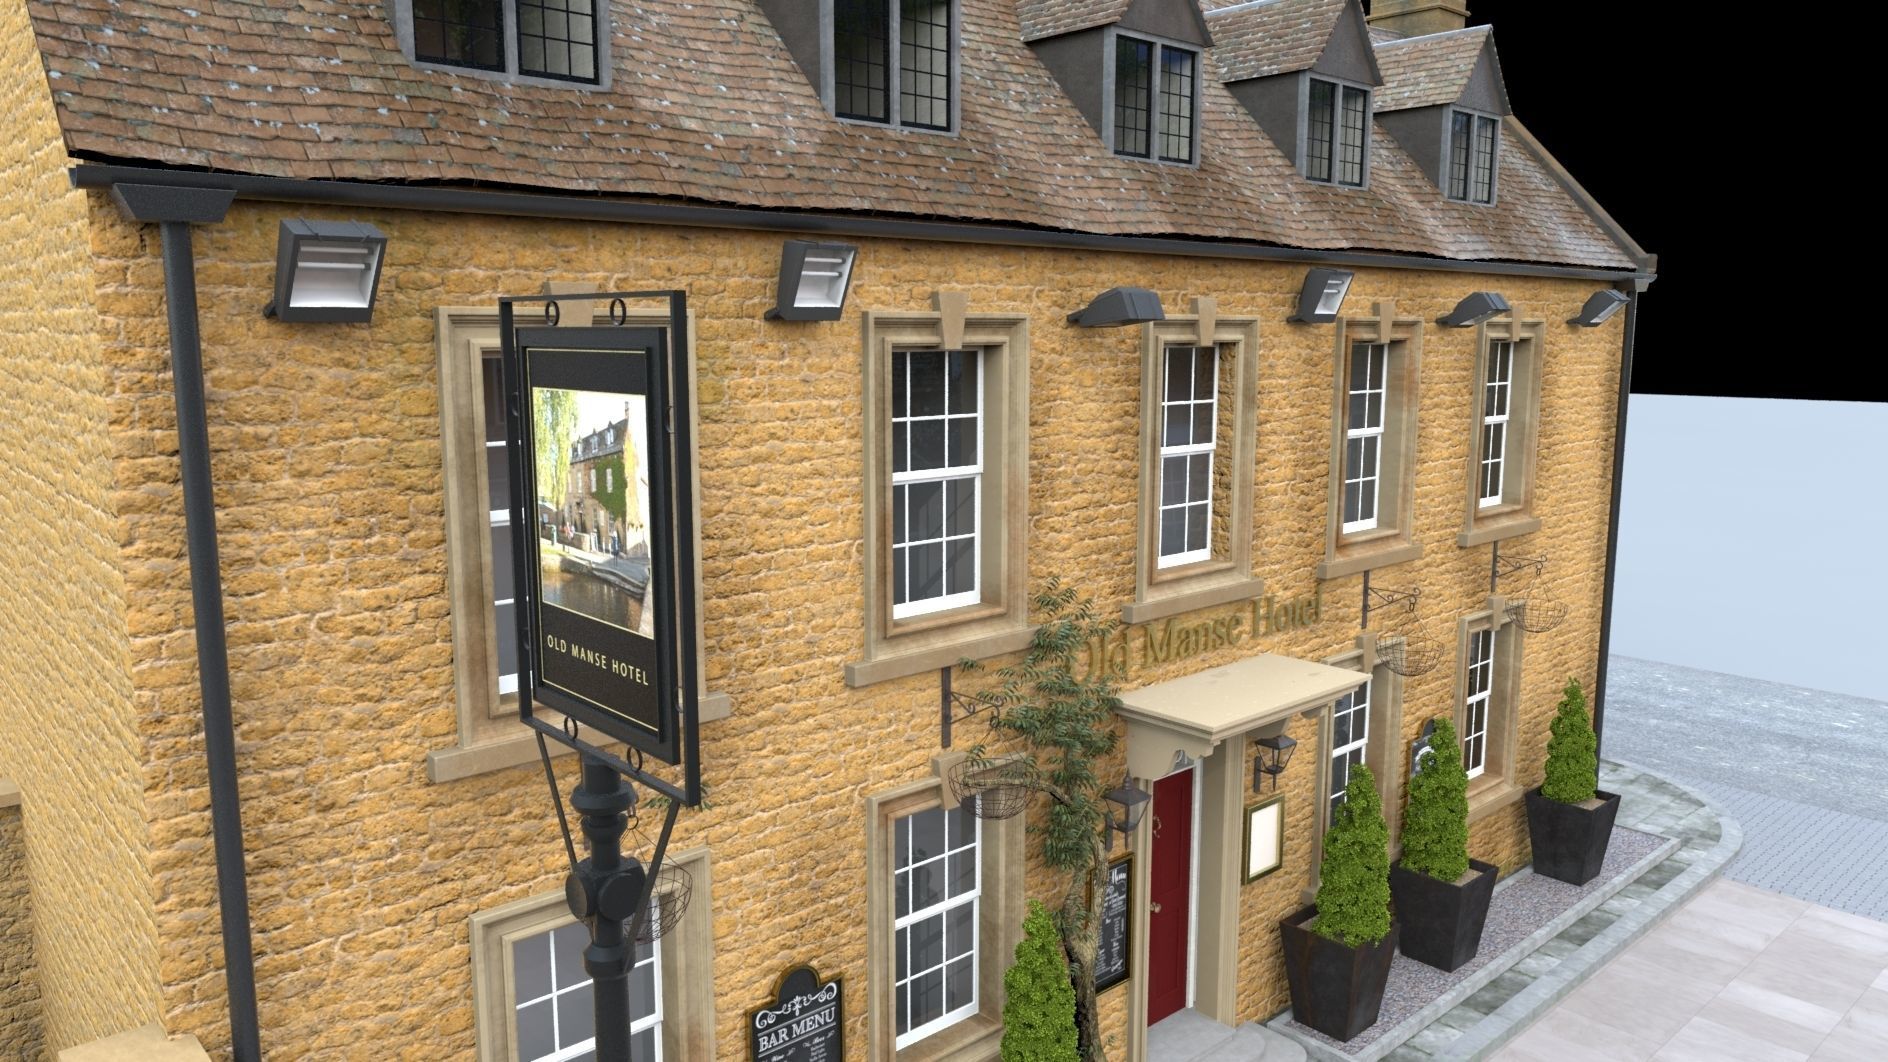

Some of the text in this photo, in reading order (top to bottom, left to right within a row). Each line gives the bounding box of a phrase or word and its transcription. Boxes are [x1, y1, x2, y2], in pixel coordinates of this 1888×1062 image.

[547, 634, 649, 686] OLD MANSE HOTEL
[1067, 582, 1322, 686] Old Manse Hotel
[758, 1007, 835, 1052] BAR MENU
